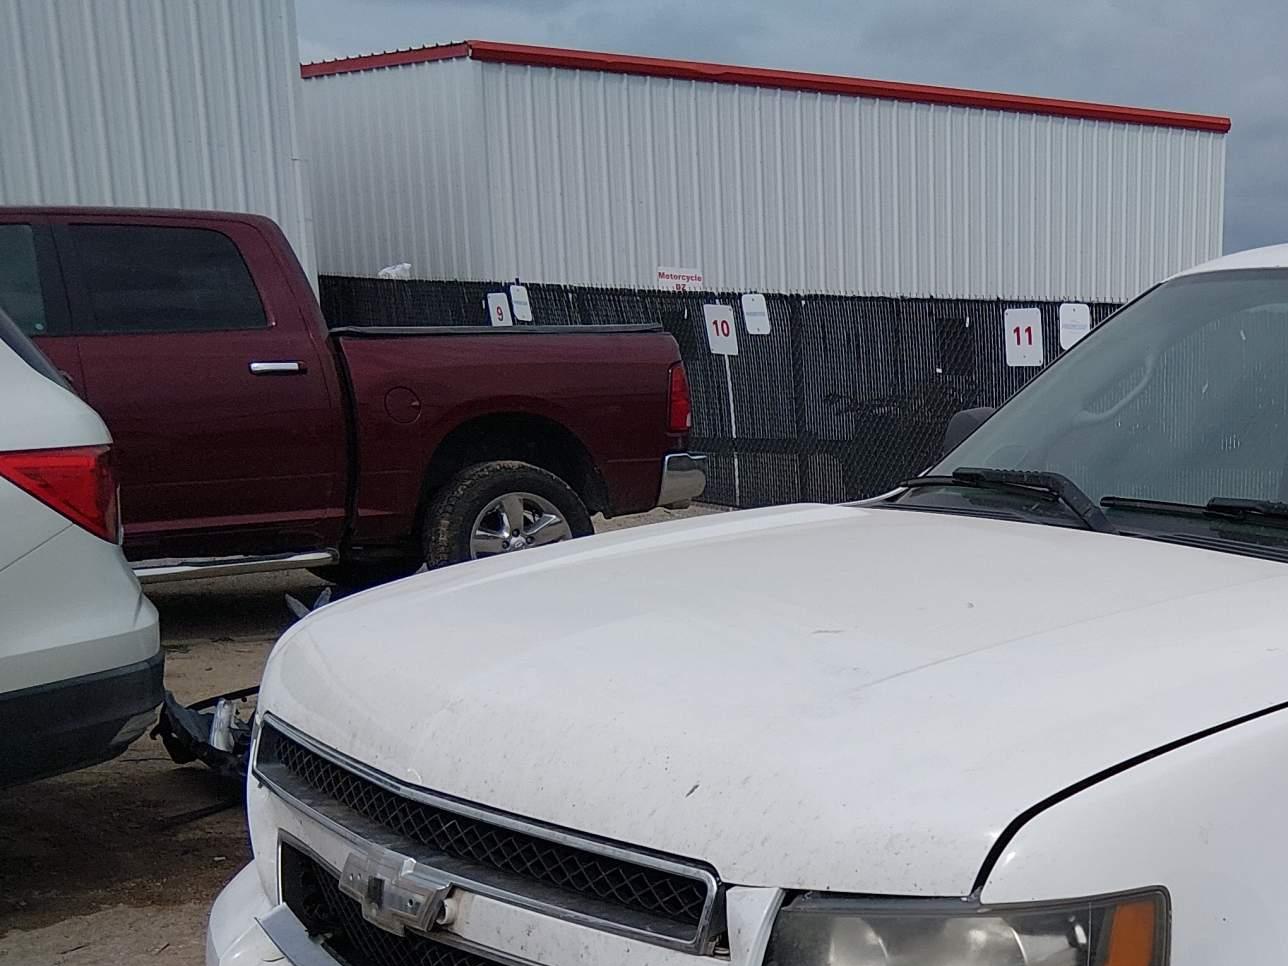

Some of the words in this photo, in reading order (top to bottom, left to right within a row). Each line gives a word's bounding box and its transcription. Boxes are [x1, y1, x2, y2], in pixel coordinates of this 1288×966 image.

[658, 271, 702, 283] Motorcycle
[496, 305, 505, 322] 9
[712, 319, 730, 338] 10
[1013, 326, 1033, 346] 11
